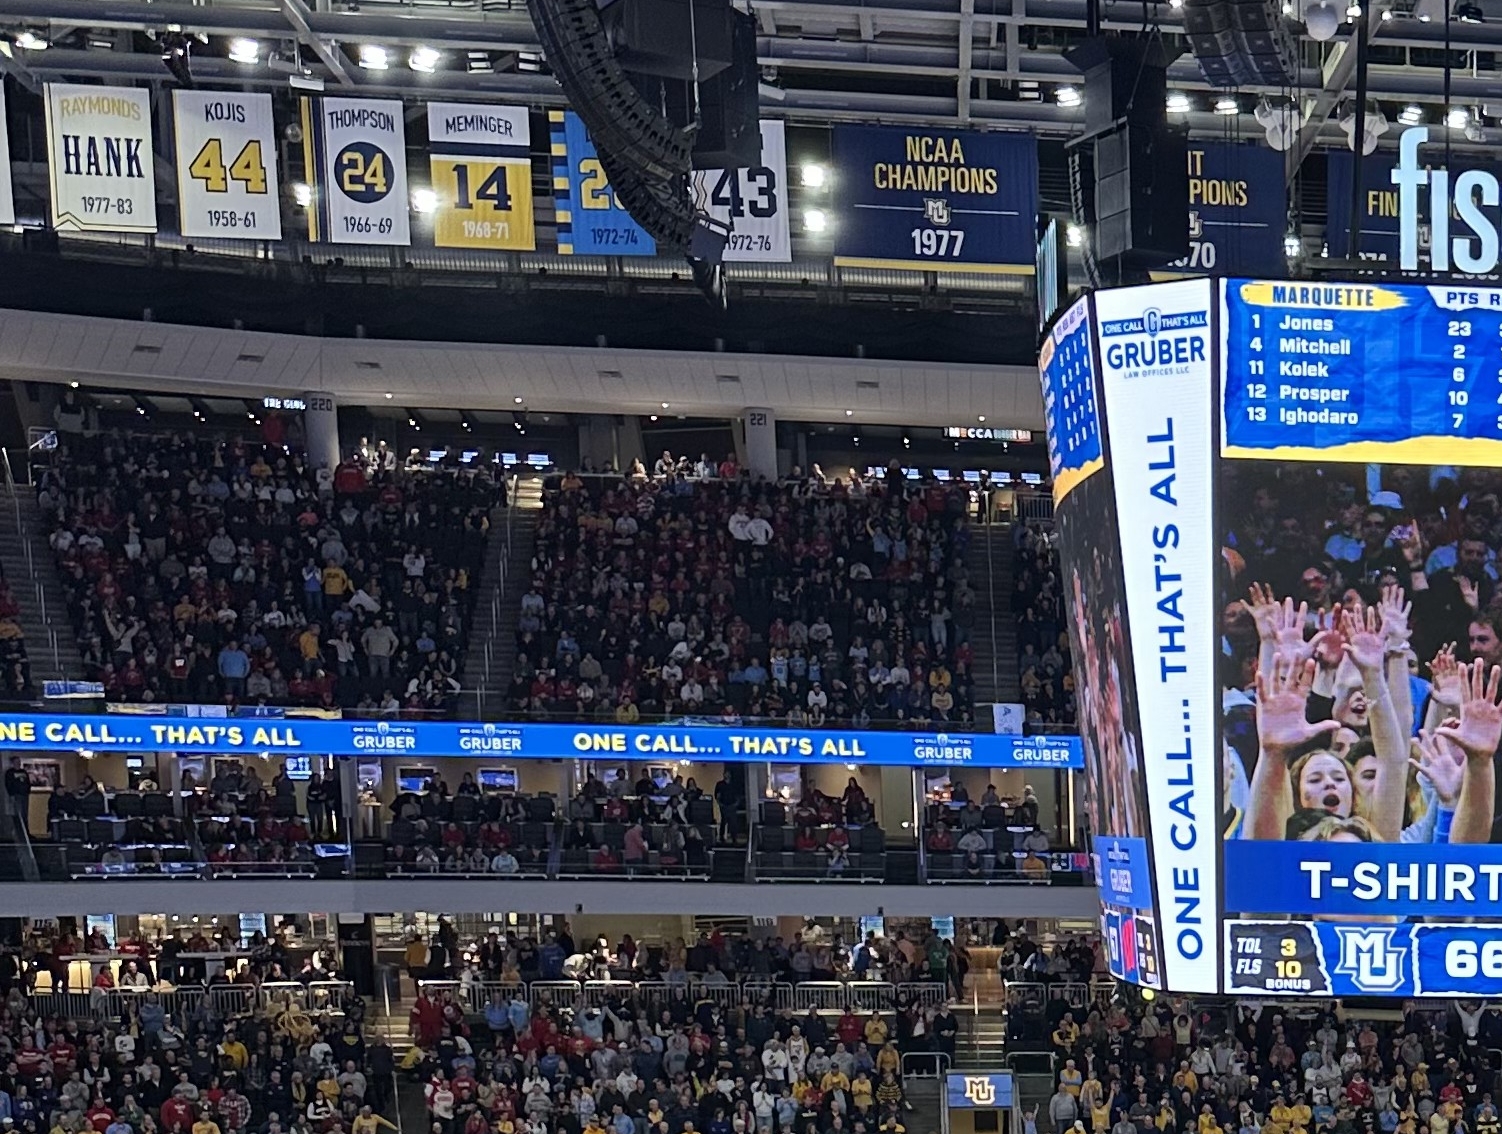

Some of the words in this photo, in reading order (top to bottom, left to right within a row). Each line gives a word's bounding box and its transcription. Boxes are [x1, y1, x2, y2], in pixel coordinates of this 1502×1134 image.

[60, 95, 141, 121] RAYMONDS
[204, 102, 246, 123] KOJIS
[328, 109, 395, 133] THOMPSON
[445, 114, 513, 138] MEMINGER
[62, 134, 145, 178] HANK
[905, 135, 965, 164] NCAA
[189, 138, 268, 194] 44
[342, 151, 387, 193] 24
[874, 162, 998, 194] CHAMPIONS
[452, 164, 512, 212] 14
[711, 166, 777, 218] 43
[81, 196, 133, 214] 1977-83
[923, 198, 951, 226] MU
[207, 210, 257, 228] 1958-61
[343, 216, 393, 234] 1966-69
[462, 221, 509, 239] 1968-71
[591, 228, 638, 245] 1972-74
[911, 228, 965, 257] 1977
[1272, 285, 1374, 306] MARQUETTE
[1446, 291, 1479, 305] PTS
[1252, 314, 1260, 328] 1
[1279, 315, 1333, 331] Jones
[1107, 336, 1206, 370] GRUBER
[1249, 337, 1262, 352] 4
[1279, 337, 1350, 355] Mitchell
[1249, 360, 1263, 375] 11
[1279, 361, 1328, 377] Kolek
[311, 398, 333, 411] 220
[1247, 384, 1266, 399] 12
[1279, 385, 1349, 403] Prosper
[750, 413, 767, 426] 221
[1247, 407, 1266, 421] 13
[1279, 408, 1358, 425] Ighodaro
[1147, 417, 1177, 505] ALL
[1153, 525, 1186, 683] THAT'S
[45, 723, 142, 744] CALL...
[150, 725, 243, 746] THAT'S
[252, 727, 301, 747] ALL
[352, 735, 416, 750] GRUBER
[573, 733, 626, 752] ONE
[635, 734, 721, 754] CALL...
[729, 736, 813, 756] THAT'S
[820, 738, 866, 757] ALL
[914, 746, 972, 760] GRUBER
[1163, 698, 1197, 851] CALL...
[1173, 868, 1203, 960] ONE
[1237, 938, 1262, 955] TOL
[1280, 938, 1297, 957] 3
[1334, 926, 1407, 992] MU
[1236, 959, 1262, 975] FLS
[1275, 960, 1302, 978] 10
[1265, 978, 1311, 990] BONUS
[964, 1077, 995, 1104] MU
